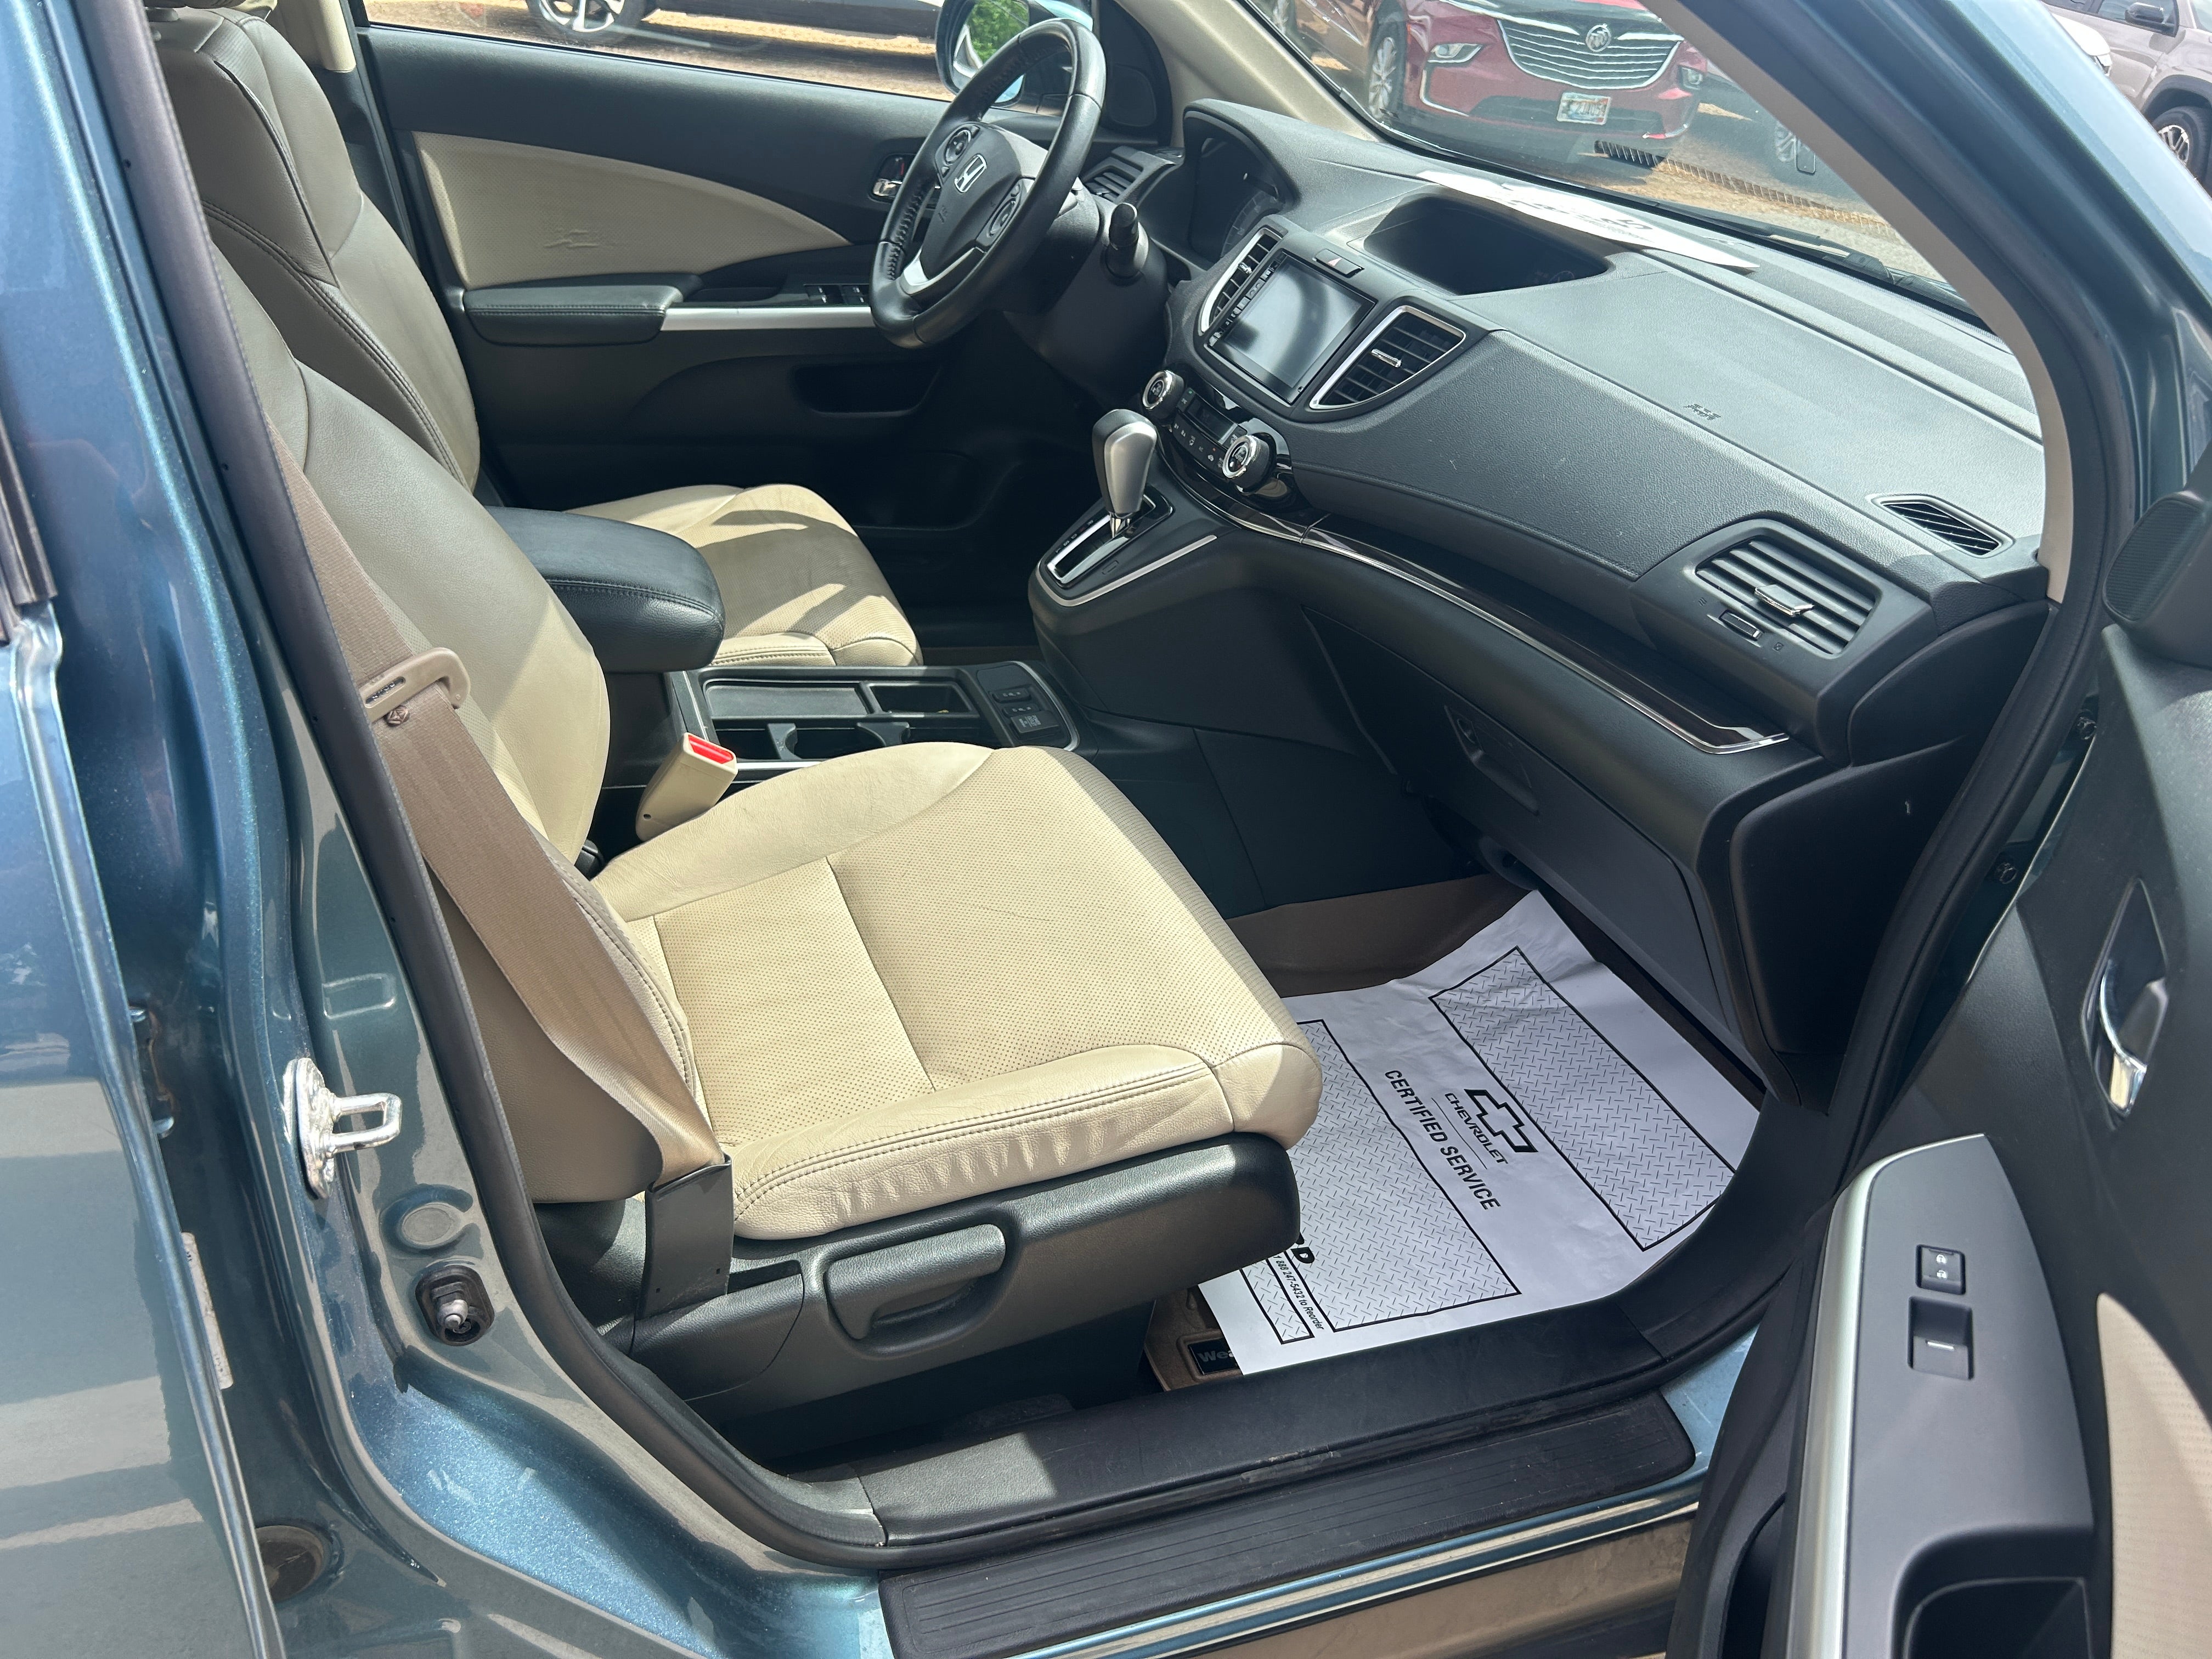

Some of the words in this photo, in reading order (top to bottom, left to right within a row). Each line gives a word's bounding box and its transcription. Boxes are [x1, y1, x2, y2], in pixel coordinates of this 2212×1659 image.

[1385, 1070, 1448, 1142] CERTIFIED
[1440, 1146, 1501, 1210] SERVICE
[1444, 1092, 1508, 1164] CHEVROLET
[1276, 1260, 1289, 1270] 888
[1283, 1271, 1305, 1299] 247-5432
[1303, 1306, 1324, 1330] Reorder
